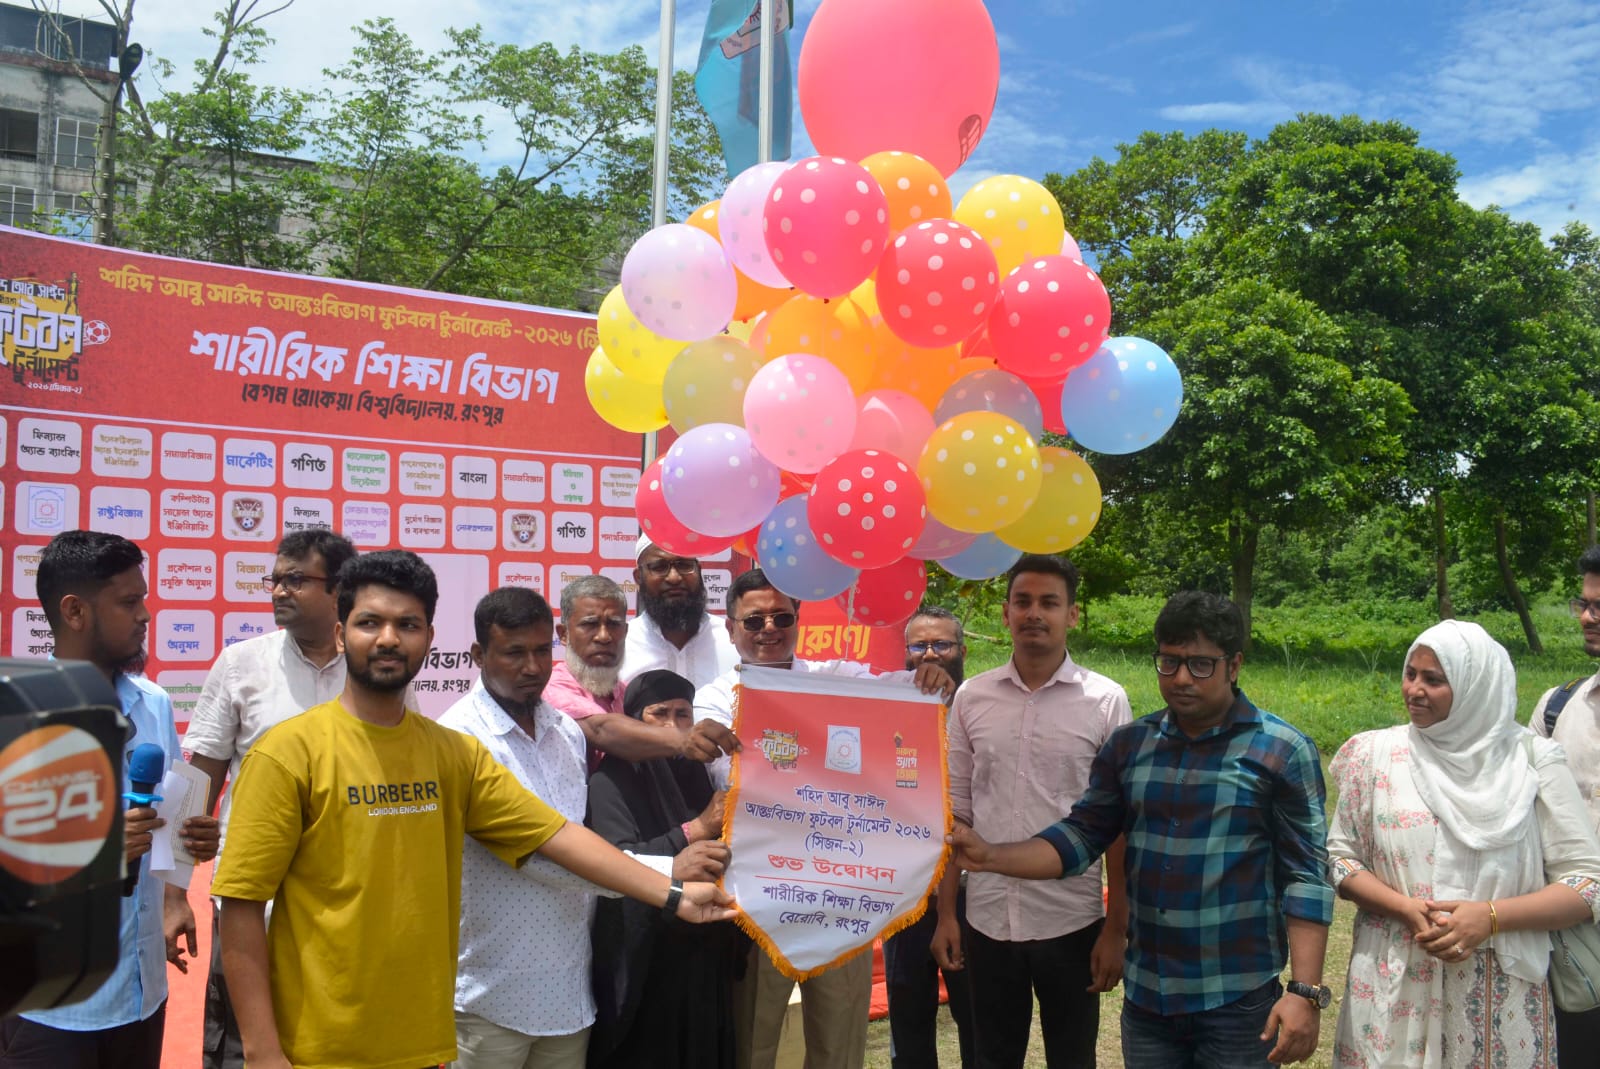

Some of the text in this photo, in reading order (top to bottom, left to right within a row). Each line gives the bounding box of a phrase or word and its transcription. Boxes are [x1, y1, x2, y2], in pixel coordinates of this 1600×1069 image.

[98, 263, 155, 295] শহিদ
[159, 276, 205, 306] আবু
[207, 282, 263, 309] সাঈদ
[267, 290, 375, 323] আন্তঃবিভাগ
[379, 305, 436, 330] ফুটবল
[439, 310, 512, 338] টুর্নামেন্ট
[189, 326, 559, 404] শারীরিক শিক্ষা বিভাগ
[242, 382, 288, 406] বেগম
[292, 385, 353, 412] রোকেয়া
[461, 402, 504, 428] রংপুর
[164, 448, 213, 461] সমাজবিজ্ঞান
[225, 451, 273, 469] মার্কেটিং
[291, 452, 327, 473] গণিত
[459, 471, 487, 485] বাংলা
[97, 504, 143, 520] রাষ্ট্রবিজ্ঞান
[557, 521, 587, 539] গণিত
[236, 561, 266, 574] বিজ্ঞান
[173, 623, 195, 633] কলা
[795, 624, 871, 660] ারুণ্যে
[424, 647, 473, 669] বিভাগ
[442, 679, 470, 694] রংপুর
[347, 781, 439, 805] BURBERR
[795, 785, 887, 811] শহিদ আবু সাঈদ
[3, 782, 104, 837] 24
[399, 803, 437, 814] ENGLAND
[745, 801, 931, 840] আন্তঃবিভাগ ফুটবল টুর্নামেন্ট ২০২৬
[767, 854, 897, 885] শুভ উদ্বোধন
[763, 883, 895, 916] শারীরিক শিক্ষা বিভাগ
[835, 915, 871, 937] রংপুর
